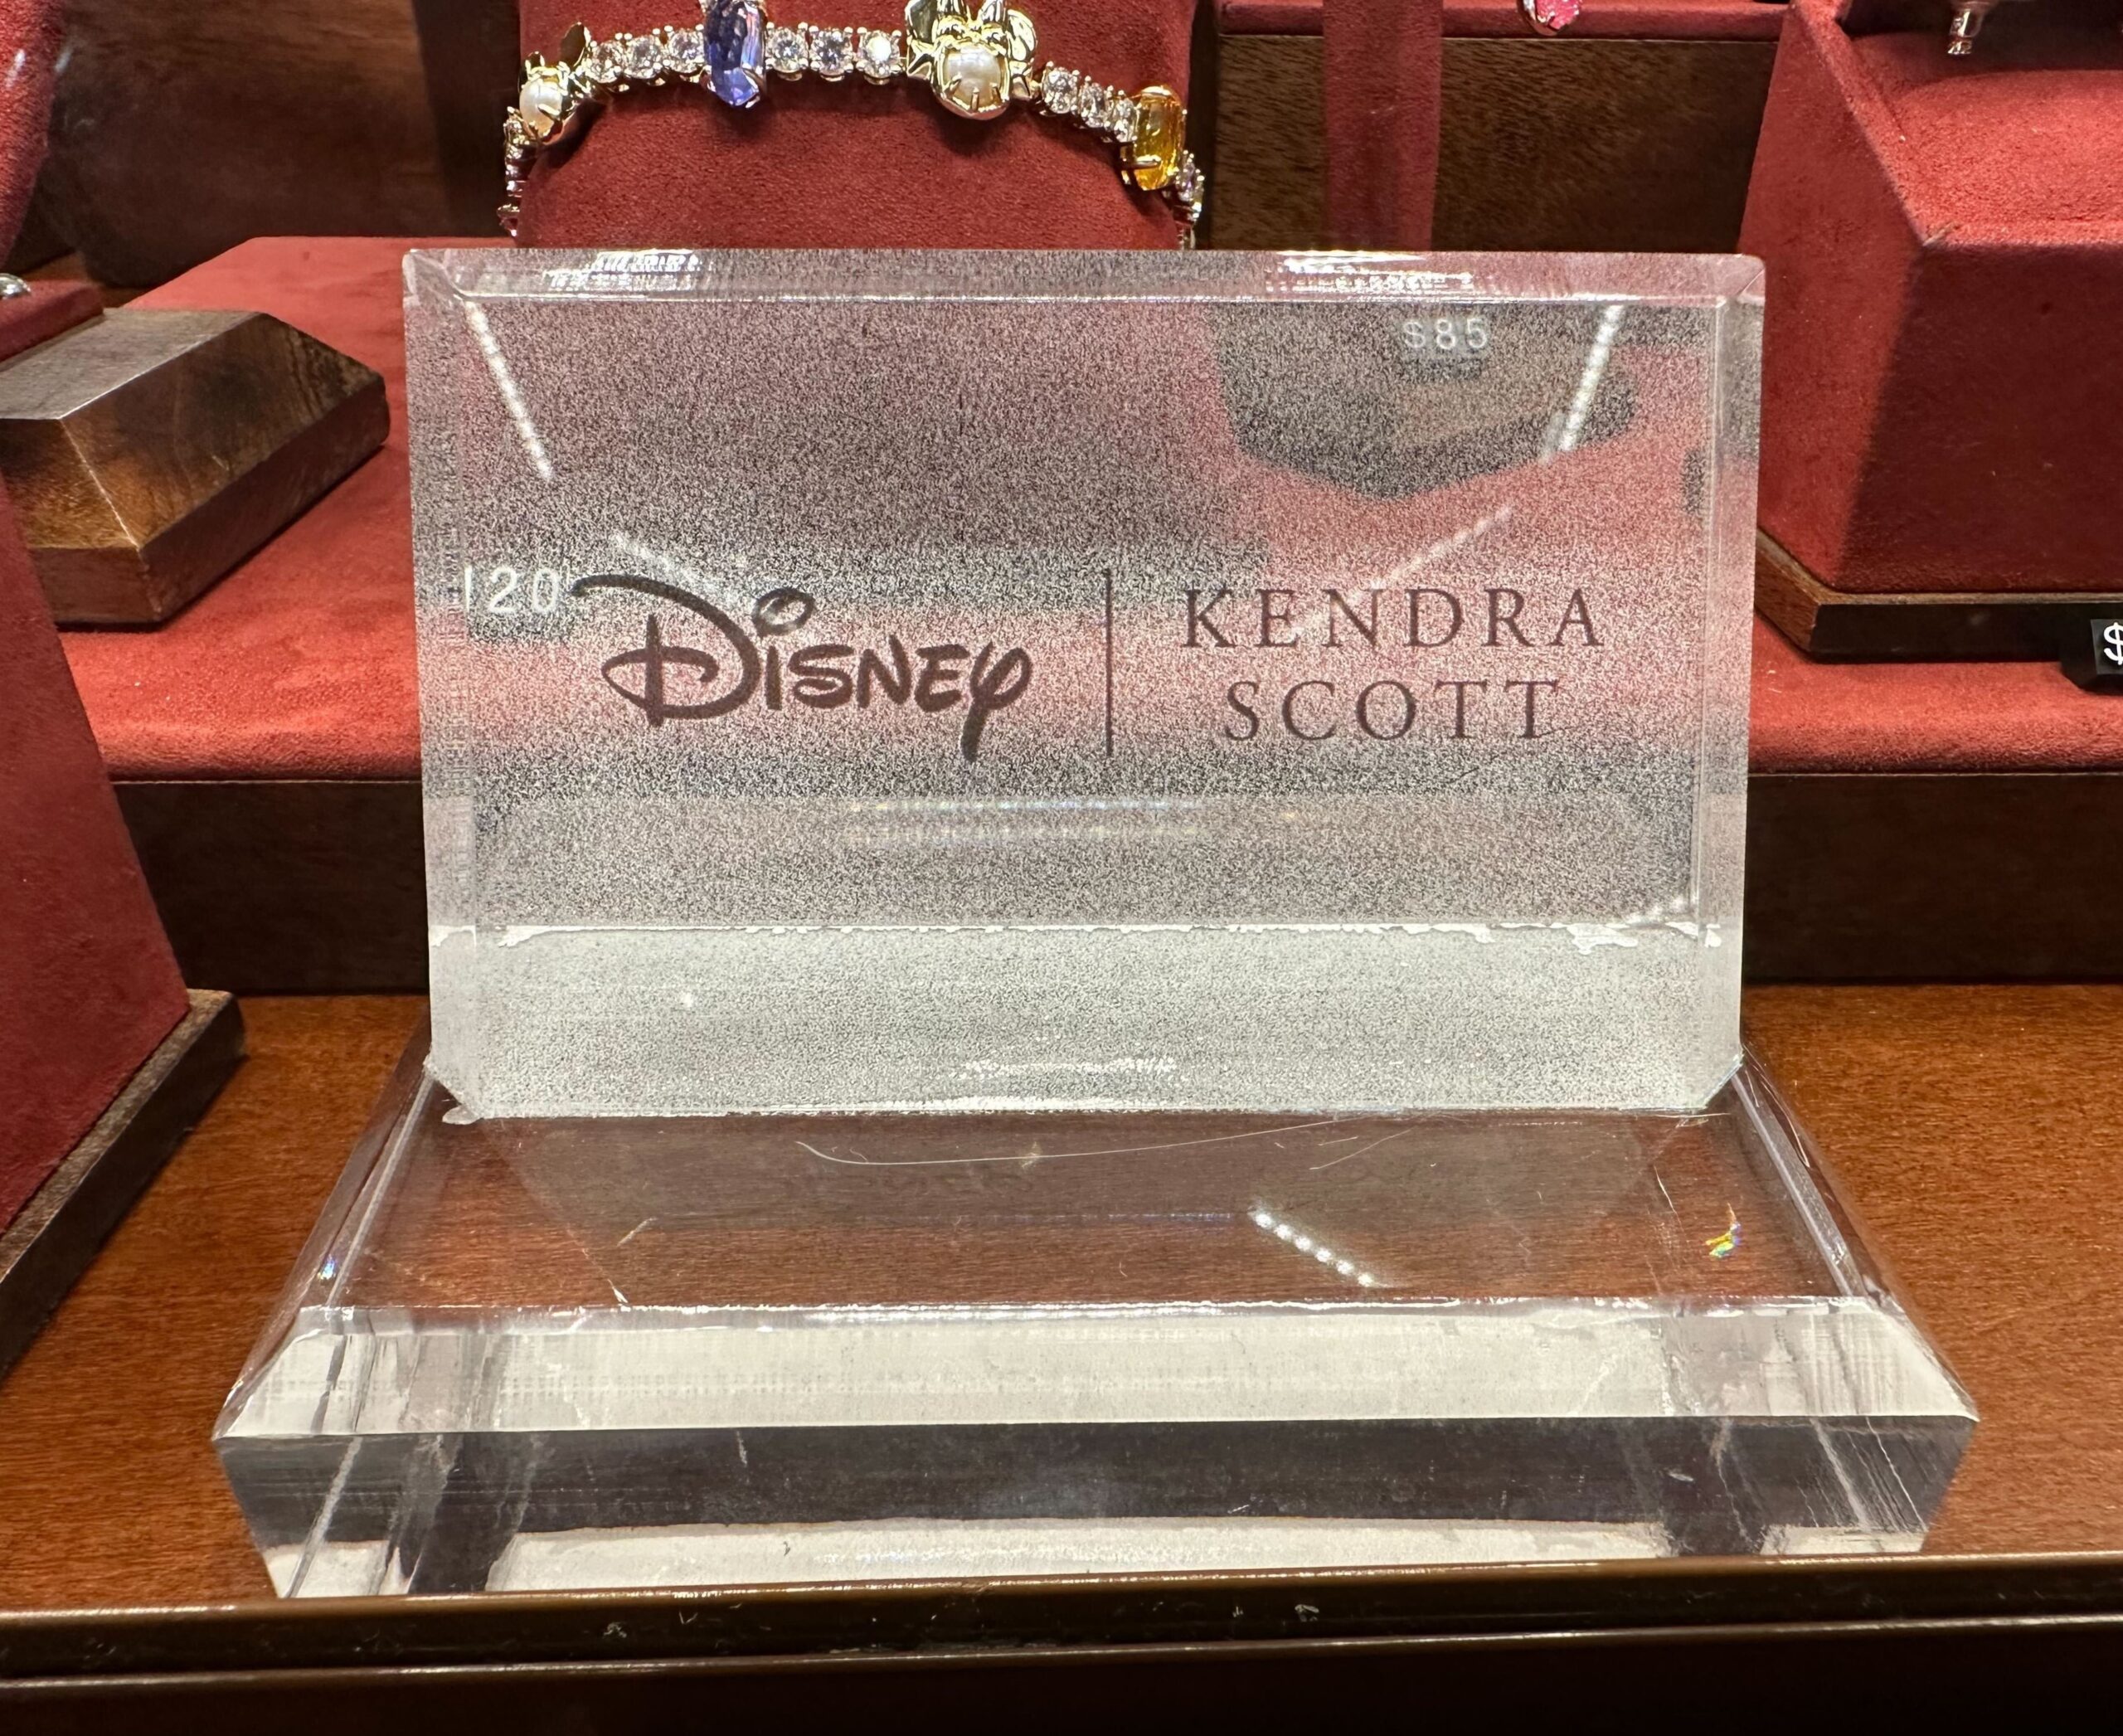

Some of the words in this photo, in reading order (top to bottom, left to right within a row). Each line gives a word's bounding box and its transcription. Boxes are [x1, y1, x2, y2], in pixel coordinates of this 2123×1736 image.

[1402, 318, 1488, 350] $85
[1180, 587, 1605, 649] KENDRA
[1224, 678, 1561, 742] SCOTT
